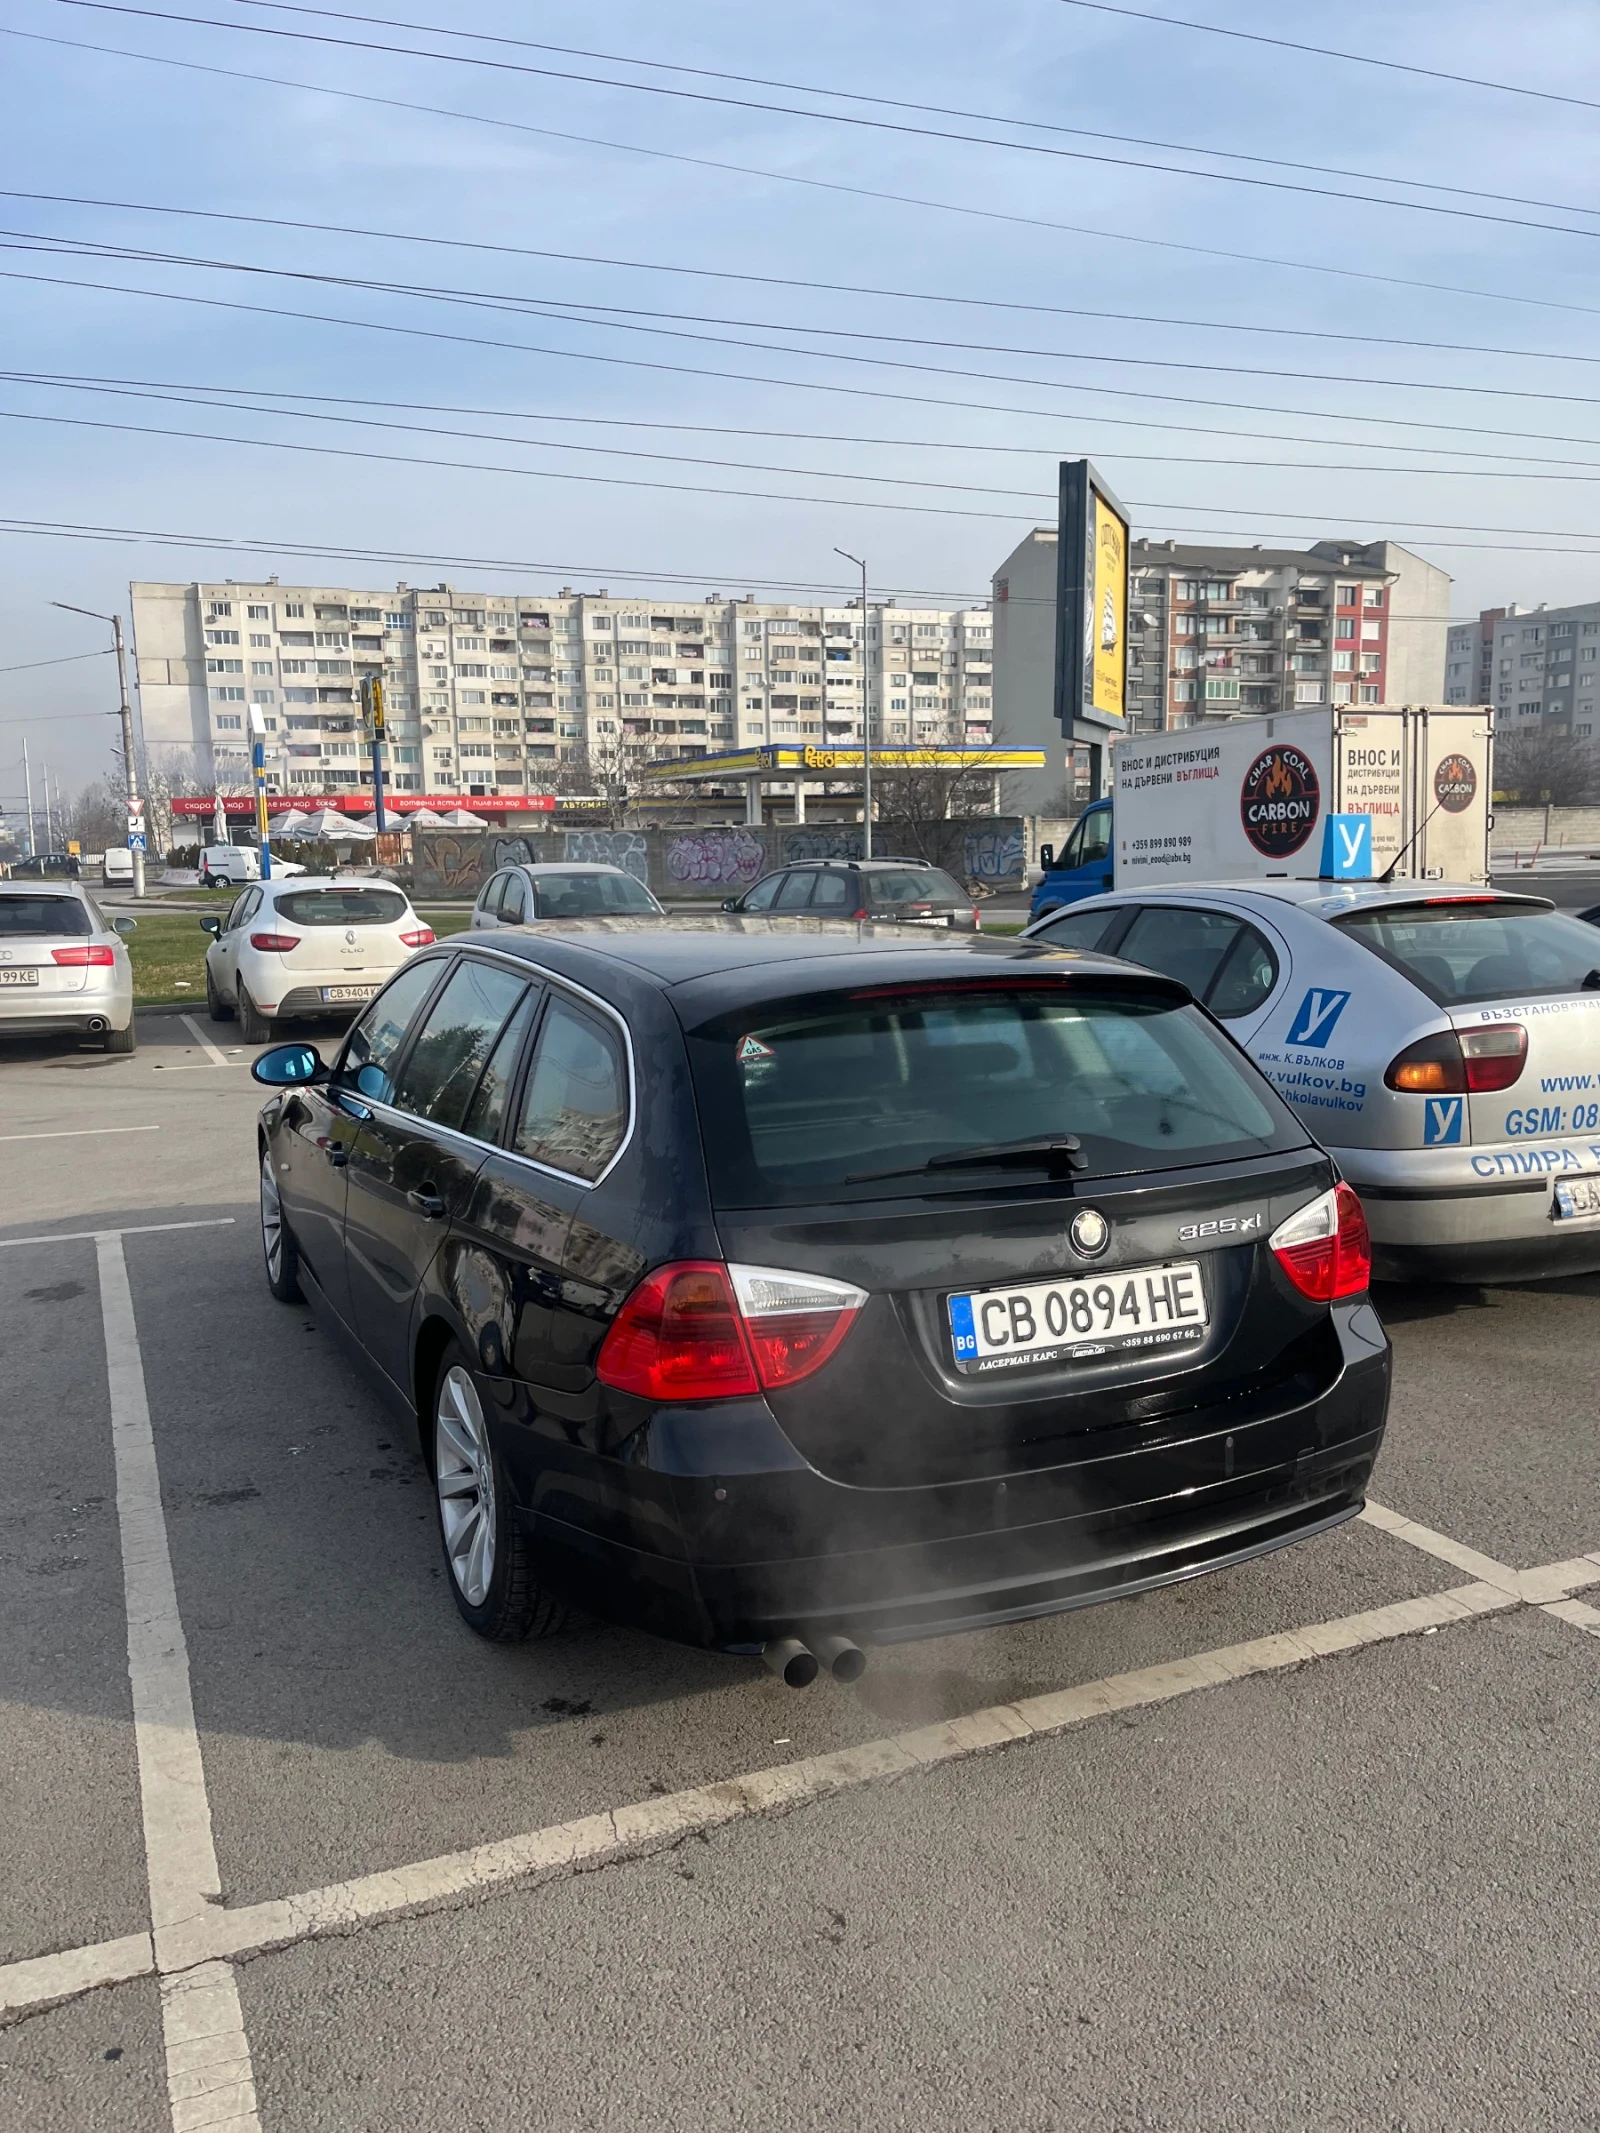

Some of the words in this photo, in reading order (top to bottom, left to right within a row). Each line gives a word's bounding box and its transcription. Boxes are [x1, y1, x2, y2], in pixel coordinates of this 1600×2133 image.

[1121, 758, 1144, 772] ВНОС
[1145, 756, 1152, 769] И
[1154, 746, 1220, 770] ДИСТРИБУЦИЯ
[1348, 749, 1387, 766] ВНОС
[1391, 749, 1400, 766] И
[1249, 754, 1273, 787] CHAR
[1283, 751, 1309, 780] COAL
[1347, 769, 1400, 779] ДИСТРИБУЦИЯ
[1121, 778, 1133, 789] НА
[1134, 772, 1173, 790] ДЪРВЕНИ
[1176, 766, 1220, 782] ВЪГЛИЩА
[1346, 784, 1359, 795] НА
[1360, 784, 1400, 797] ДЪРВЕНИ
[1438, 783, 1473, 794] CARBON
[184, 802, 212, 811] скара
[1248, 800, 1310, 822] CARBON
[1347, 802, 1400, 817] ВЪГЛИЩА
[1262, 821, 1298, 835] FIRE
[1132, 839, 1148, 850] +359
[1149, 838, 1162, 849] 899
[1163, 837, 1176, 848] 890
[1178, 835, 1192, 847] 989
[0, 971, 17, 982] 99
[745, 1047, 762, 1055] GAS
[1258, 1052, 1281, 1063] инж.
[1540, 1073, 1600, 1093] www.
[1280, 1088, 1364, 1113] hkolavulkov
[1505, 1106, 1567, 1136] GSM:
[1572, 1103, 1600, 1130] 08
[1470, 1149, 1583, 1177] СПИРА
[1045, 1280, 1141, 1337] 0894
[957, 1335, 975, 1351] BG
[1122, 1337, 1141, 1347] +359
[1143, 1335, 1154, 1344] 88
[1155, 1332, 1171, 1342] 690
[1172, 1330, 1183, 1340] 67
[978, 1354, 1031, 1371] ЛАСЕРМАН
[1032, 1350, 1058, 1362] КАРС
